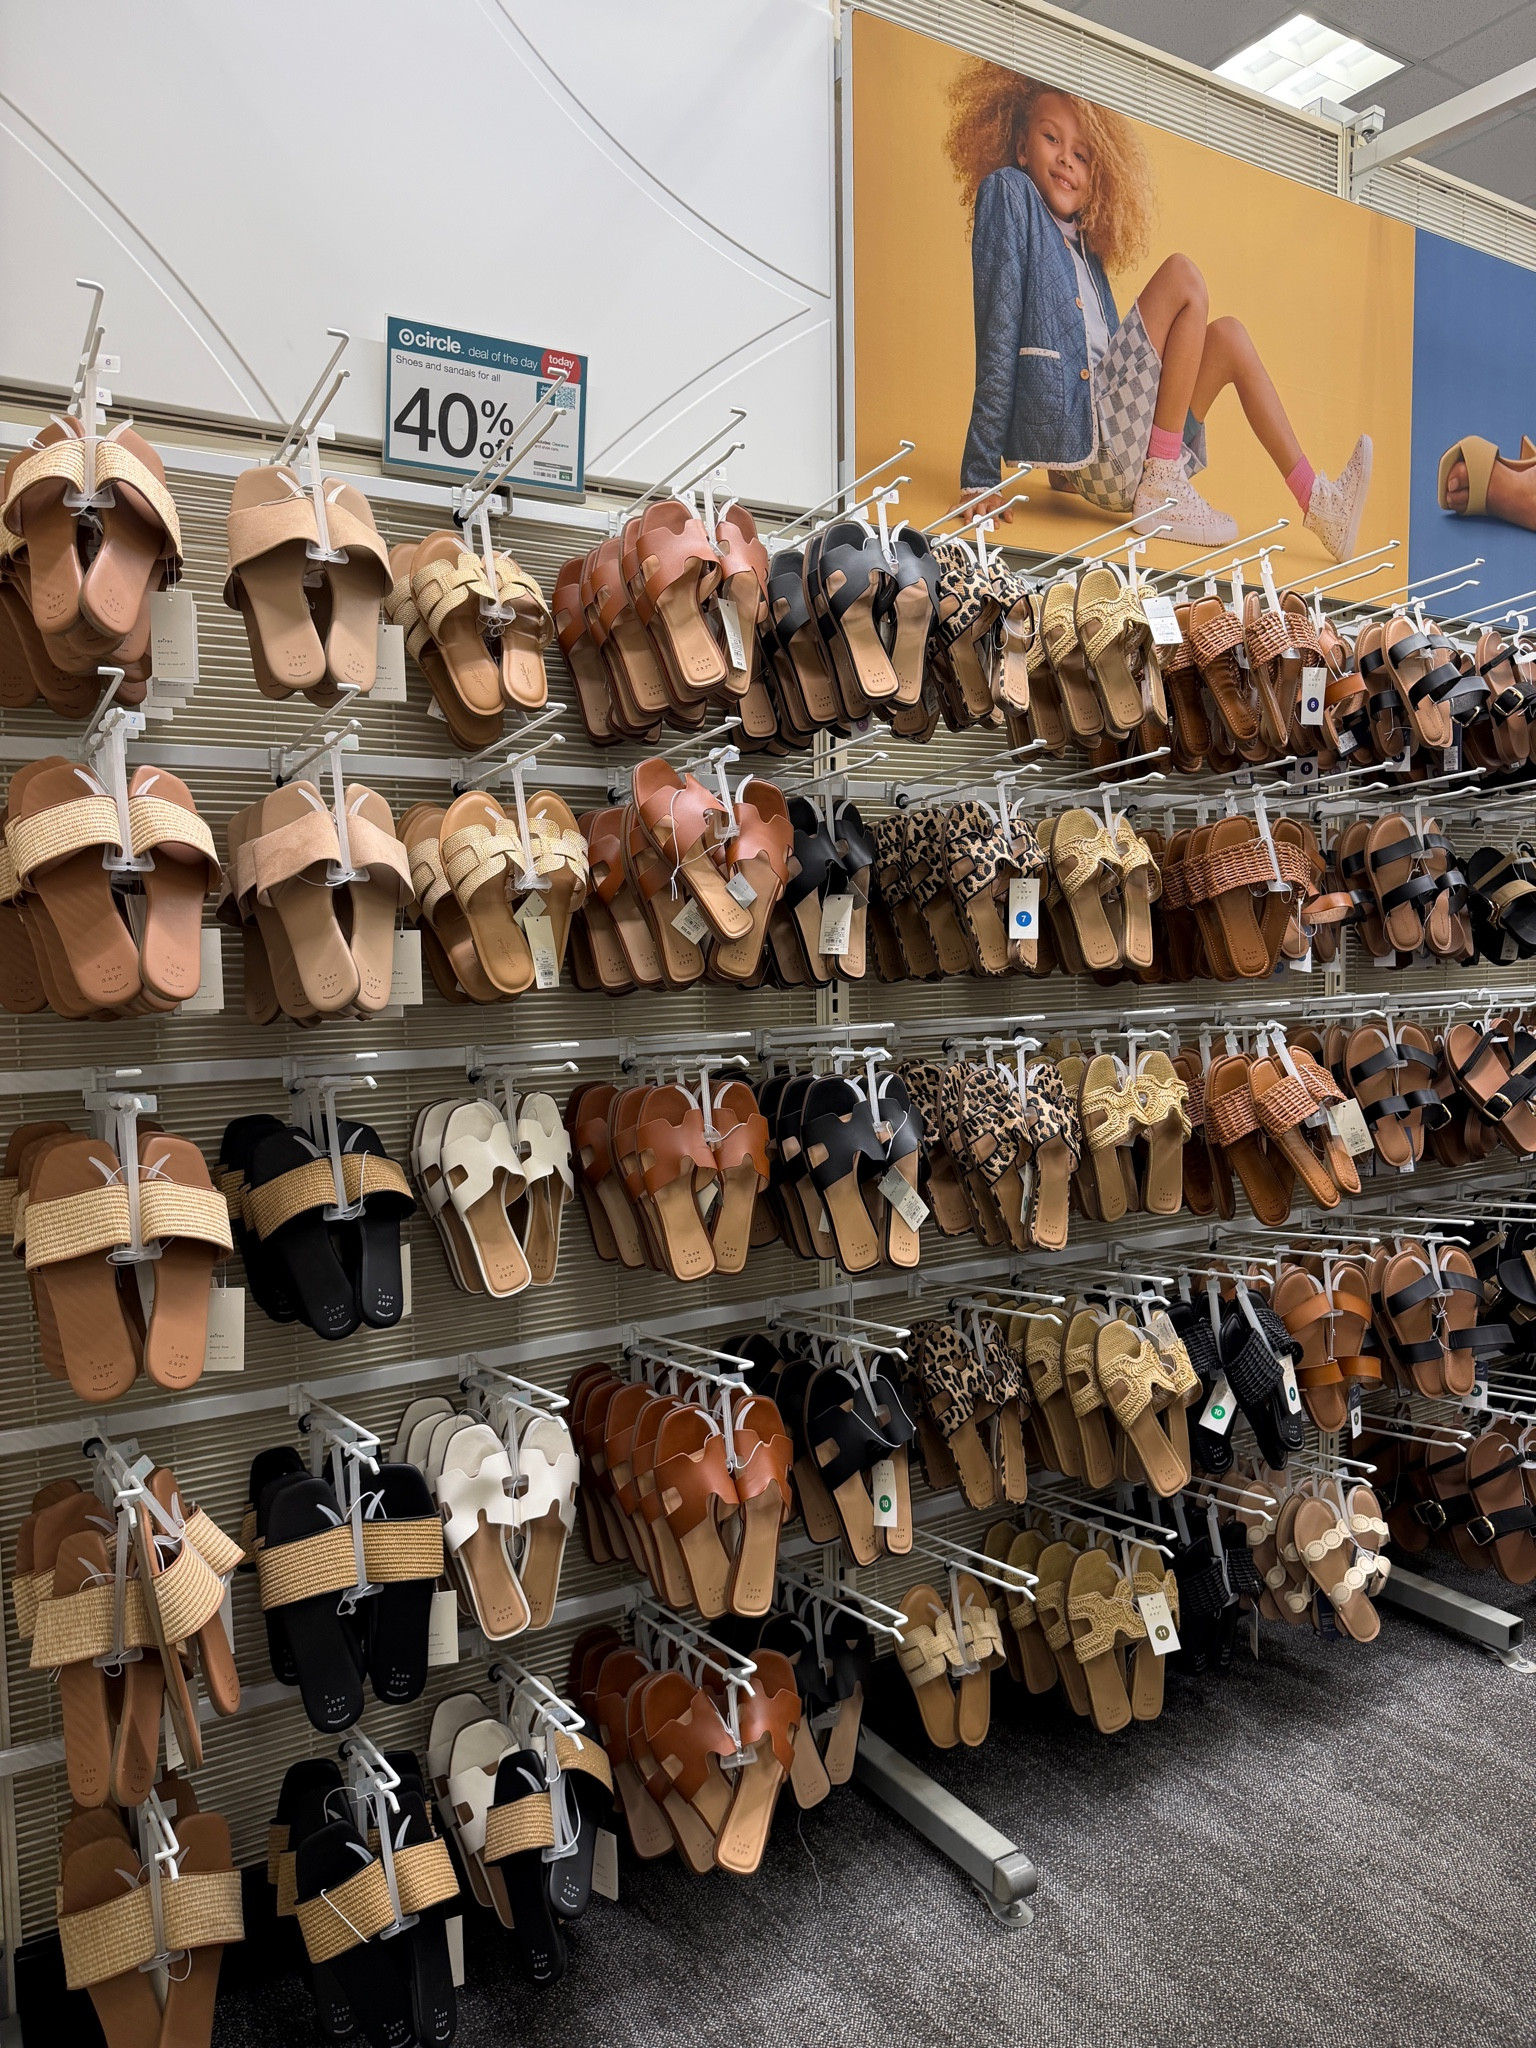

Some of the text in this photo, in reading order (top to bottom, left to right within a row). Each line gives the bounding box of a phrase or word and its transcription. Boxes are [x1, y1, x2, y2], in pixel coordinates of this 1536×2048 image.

[415, 331, 538, 371] circle deal of the day
[395, 354, 501, 382] Shoes and sandals for all
[549, 354, 575, 369] today
[479, 438, 515, 462] off
[1020, 915, 1027, 923] 7
[882, 1500, 889, 1508] 10
[1157, 1629, 1167, 1637] 11
